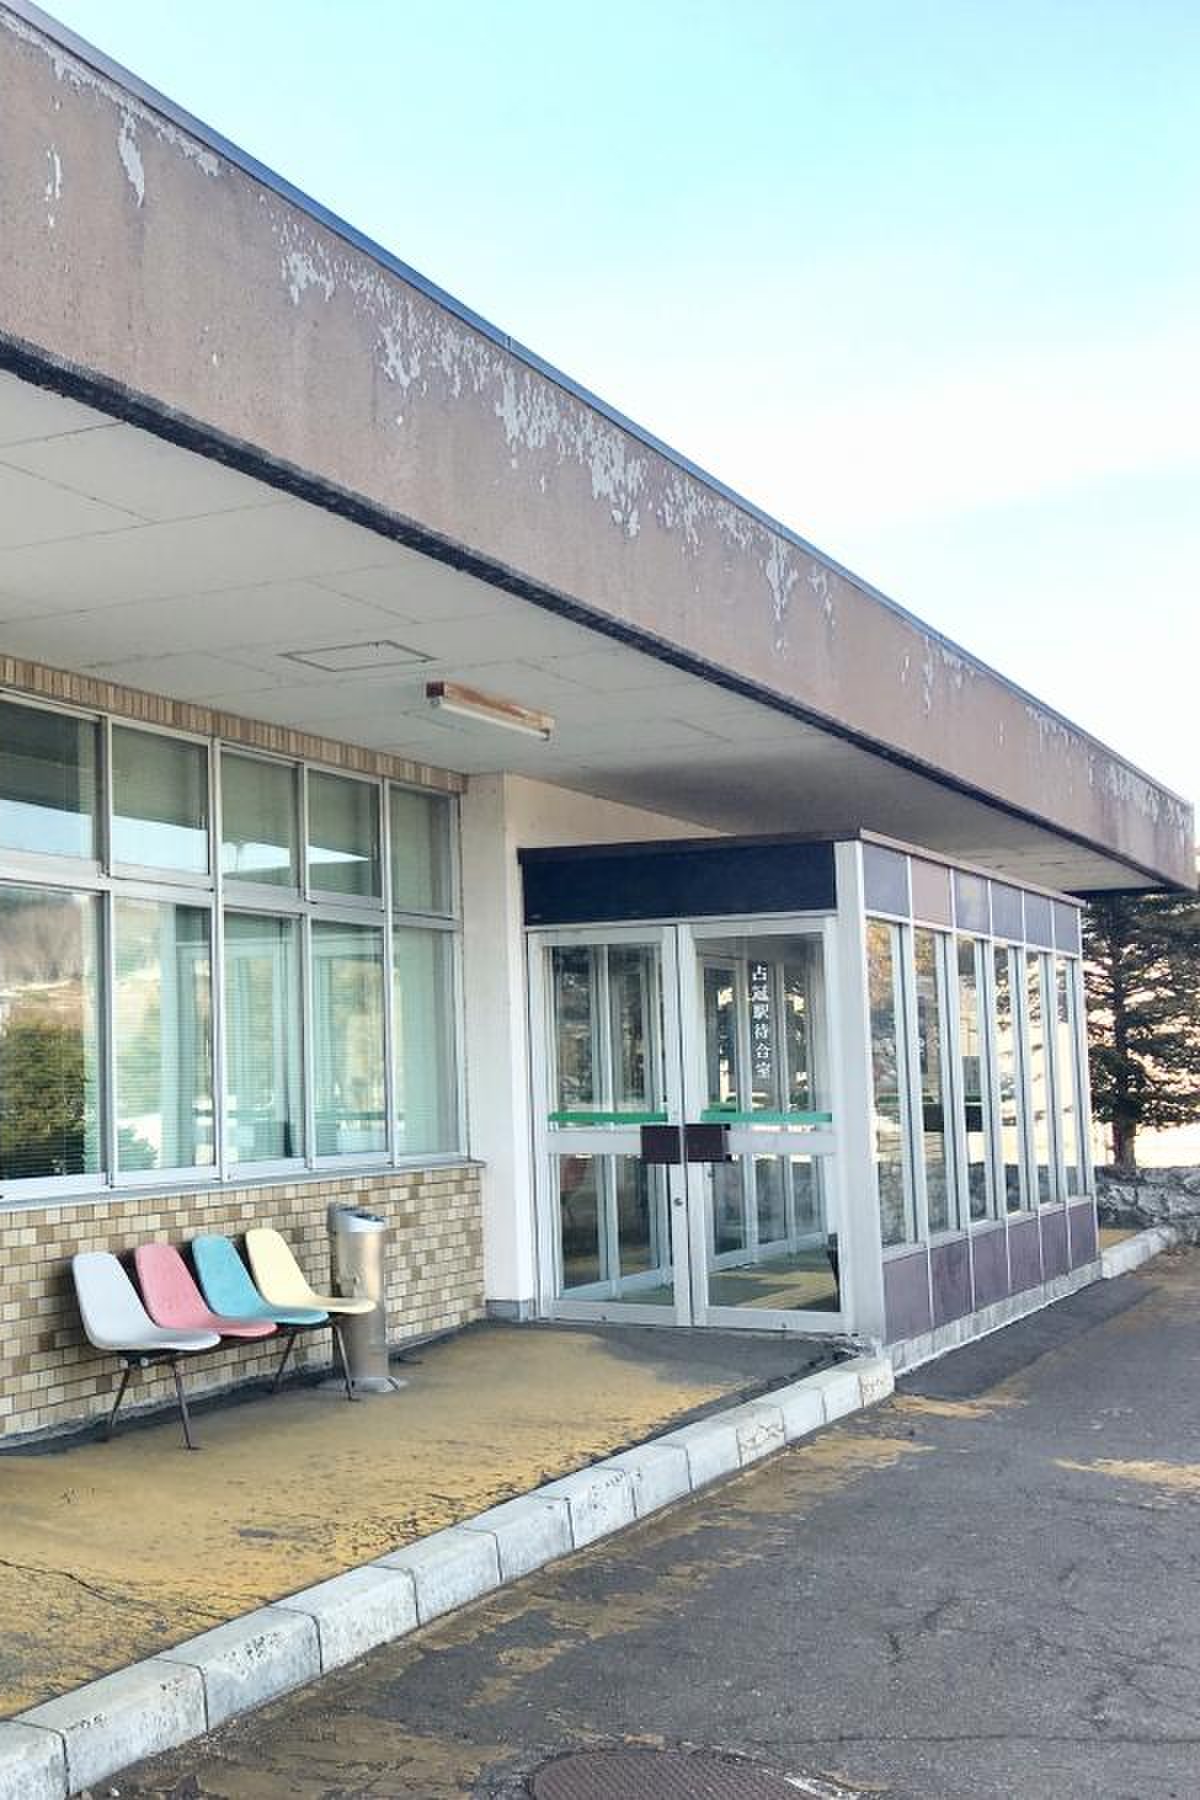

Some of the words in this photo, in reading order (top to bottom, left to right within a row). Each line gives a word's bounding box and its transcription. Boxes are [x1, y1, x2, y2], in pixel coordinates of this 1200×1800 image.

[751, 965, 771, 1079] 占冠駅待合室
